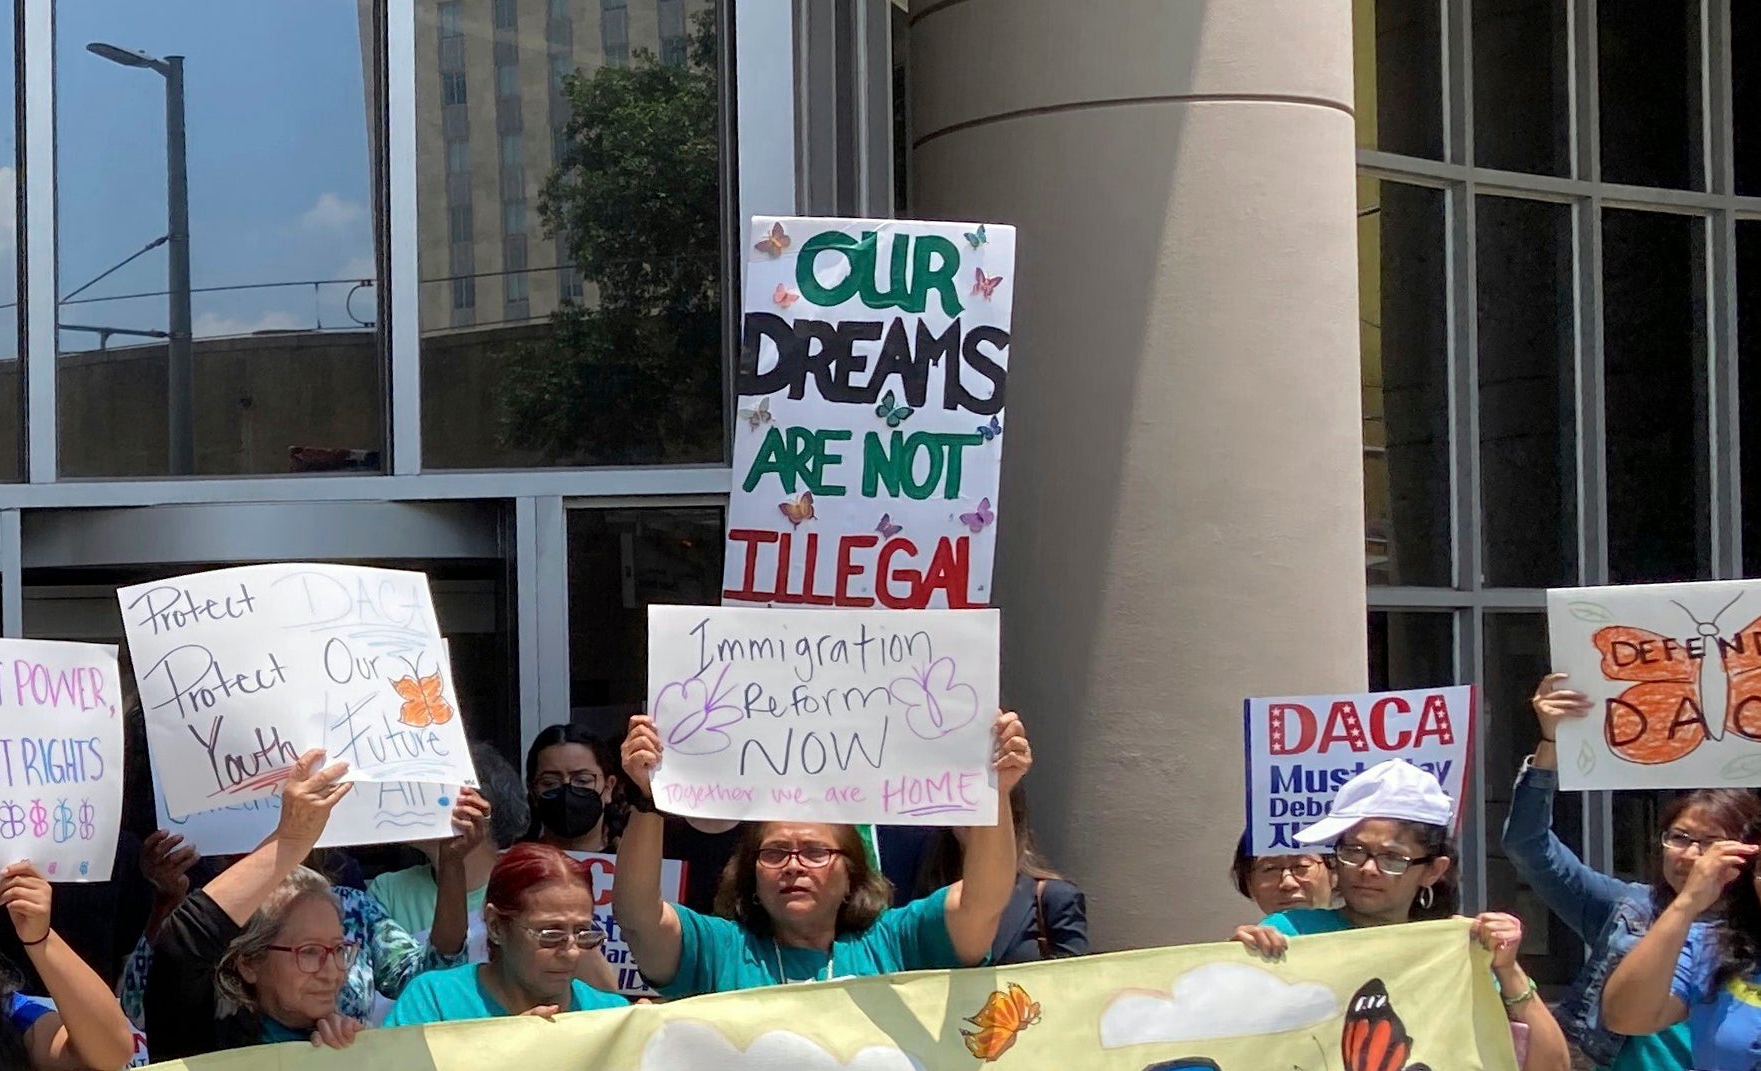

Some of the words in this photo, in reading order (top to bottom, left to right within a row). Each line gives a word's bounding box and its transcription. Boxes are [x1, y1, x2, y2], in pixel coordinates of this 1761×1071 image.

[796, 230, 965, 318] OUR
[738, 312, 1010, 415] DREAMS
[743, 426, 852, 495] ARE
[862, 429, 984, 500] NOT
[724, 529, 991, 610] ILLEGAL
[128, 583, 256, 635] Protect
[271, 571, 430, 632] DACA
[143, 644, 288, 719] Protect
[324, 637, 380, 684] Our
[690, 617, 933, 683] Immigration
[13, 659, 116, 719] POWER,
[744, 682, 891, 719] Reform
[188, 714, 300, 792] Youth
[330, 691, 450, 768] Future
[739, 715, 889, 776] NOW
[1269, 694, 1455, 756] DACA
[21, 736, 105, 787] RIGHTS
[772, 785, 810, 804] we
[825, 787, 866, 804] are
[883, 771, 983, 813] HOME
